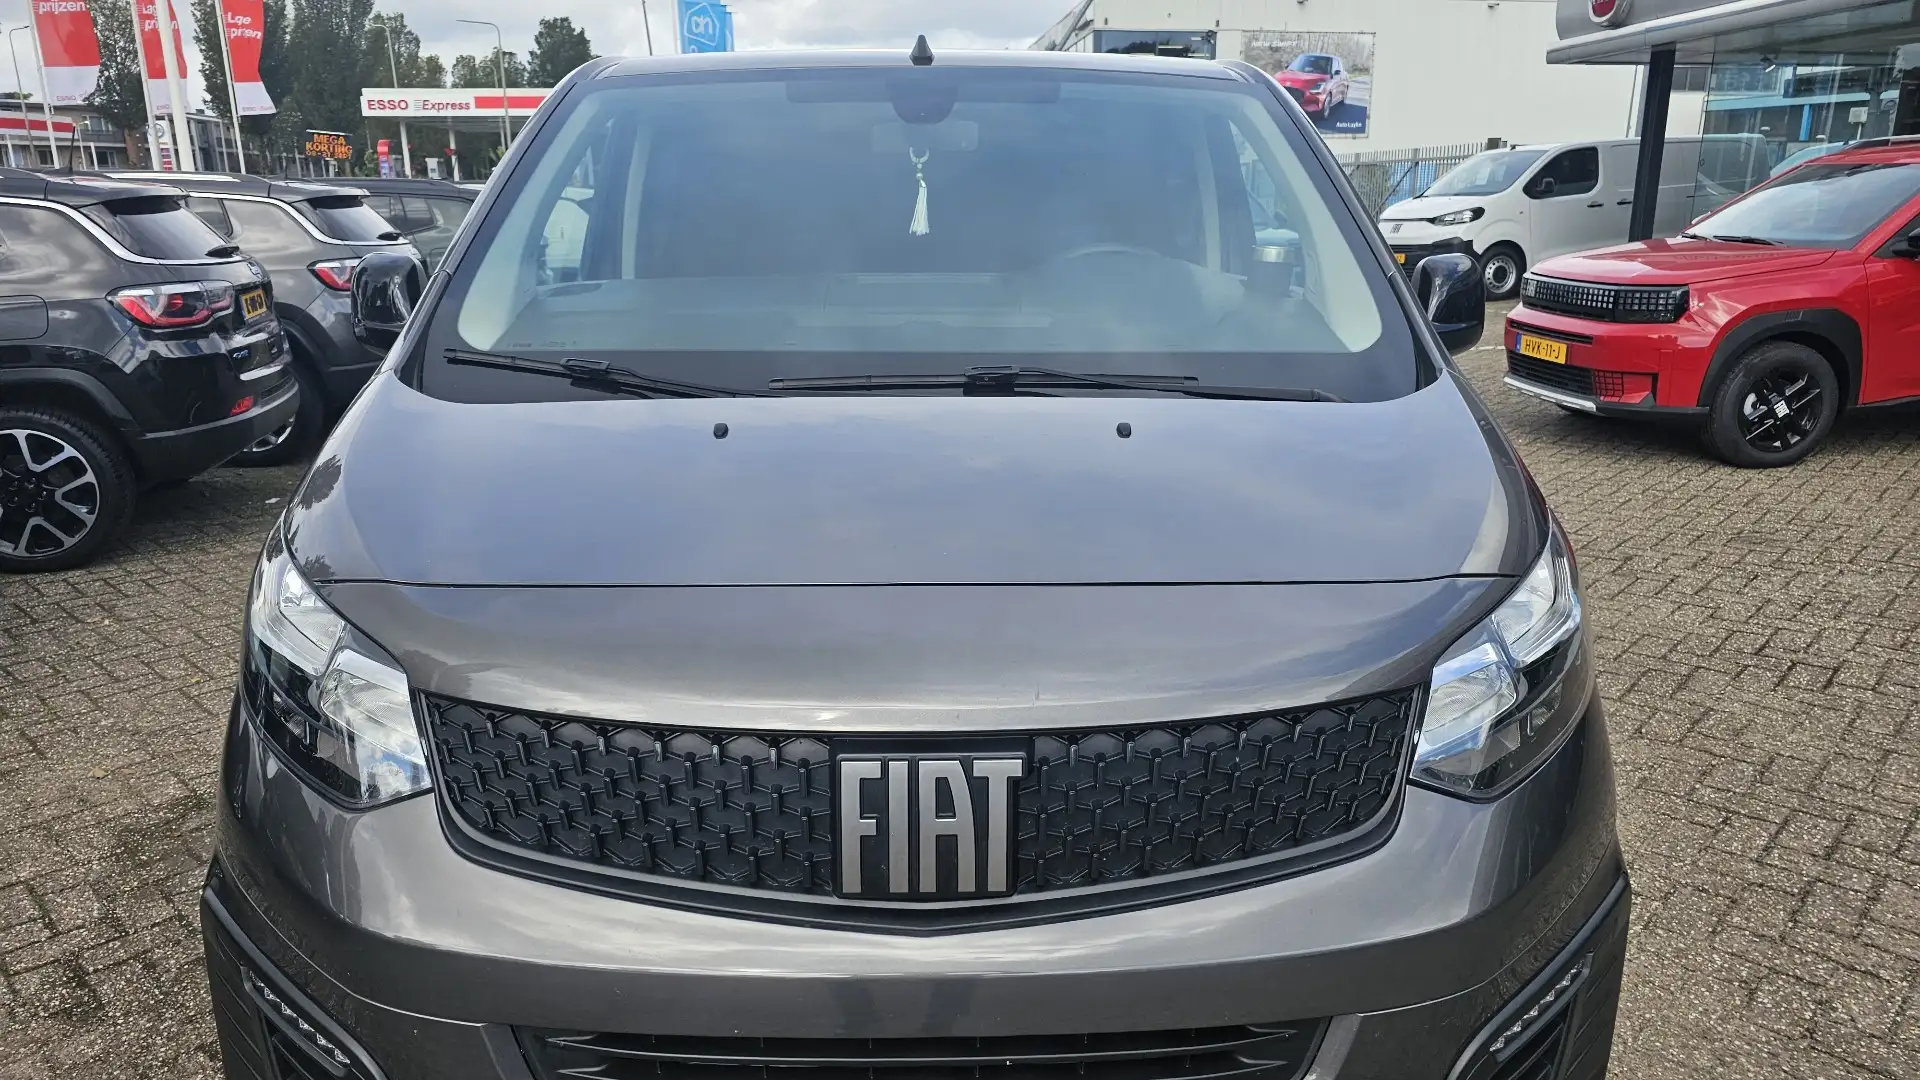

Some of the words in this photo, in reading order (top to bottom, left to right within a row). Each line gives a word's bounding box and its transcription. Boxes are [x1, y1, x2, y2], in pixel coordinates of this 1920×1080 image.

[367, 99, 409, 110] ESSO
[422, 99, 471, 113] Express
[313, 133, 346, 145] MEGA
[305, 141, 353, 154] KORTING
[1525, 338, 1560, 360] HVK-11-J
[841, 759, 1023, 893] FIAT
